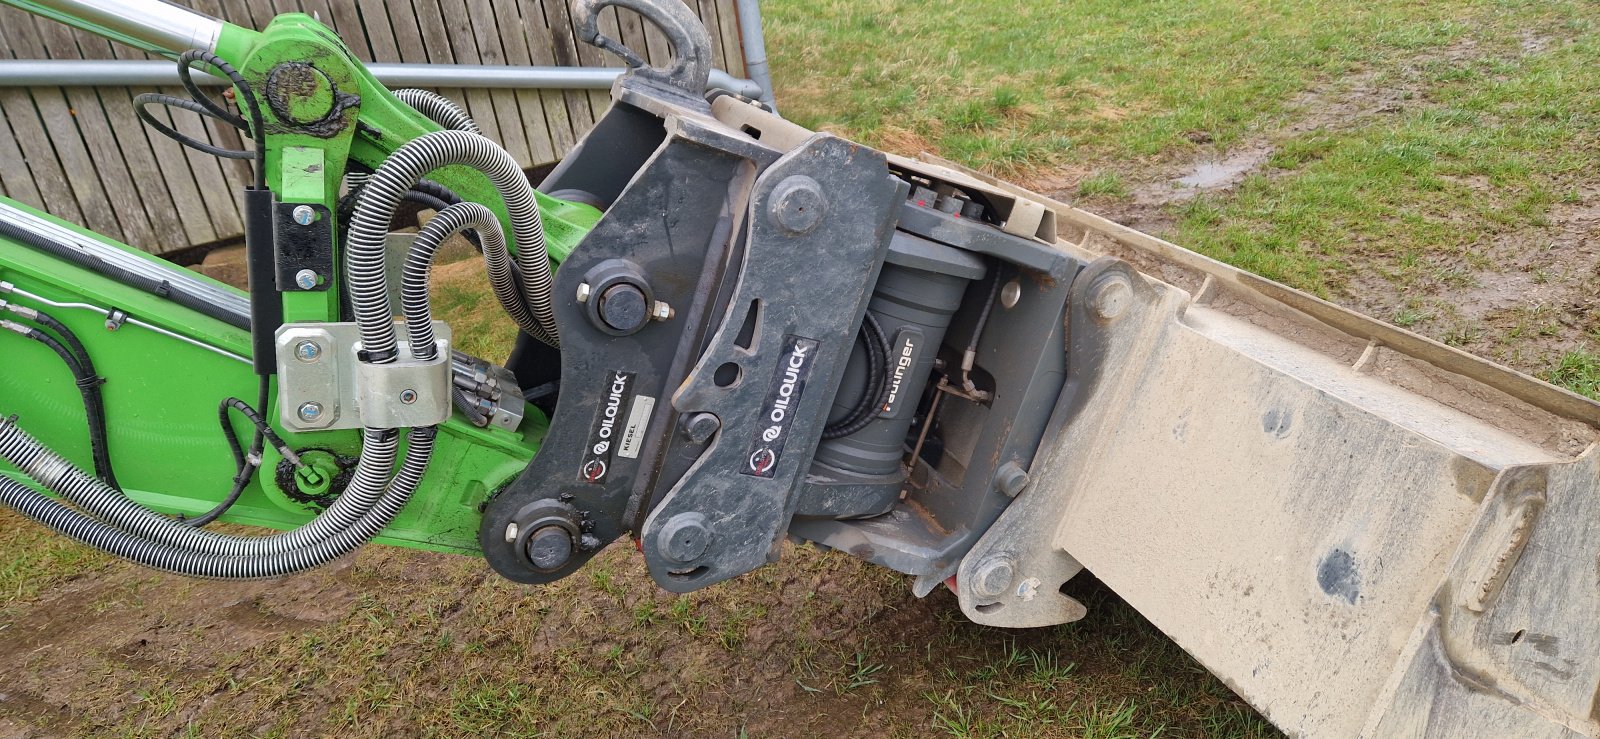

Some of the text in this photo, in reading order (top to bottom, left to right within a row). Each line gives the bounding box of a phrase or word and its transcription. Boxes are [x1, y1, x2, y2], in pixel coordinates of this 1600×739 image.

[600, 374, 627, 439] OILQUICK
[771, 344, 808, 422] OILQUICK
[623, 424, 636, 451] KIESEL
